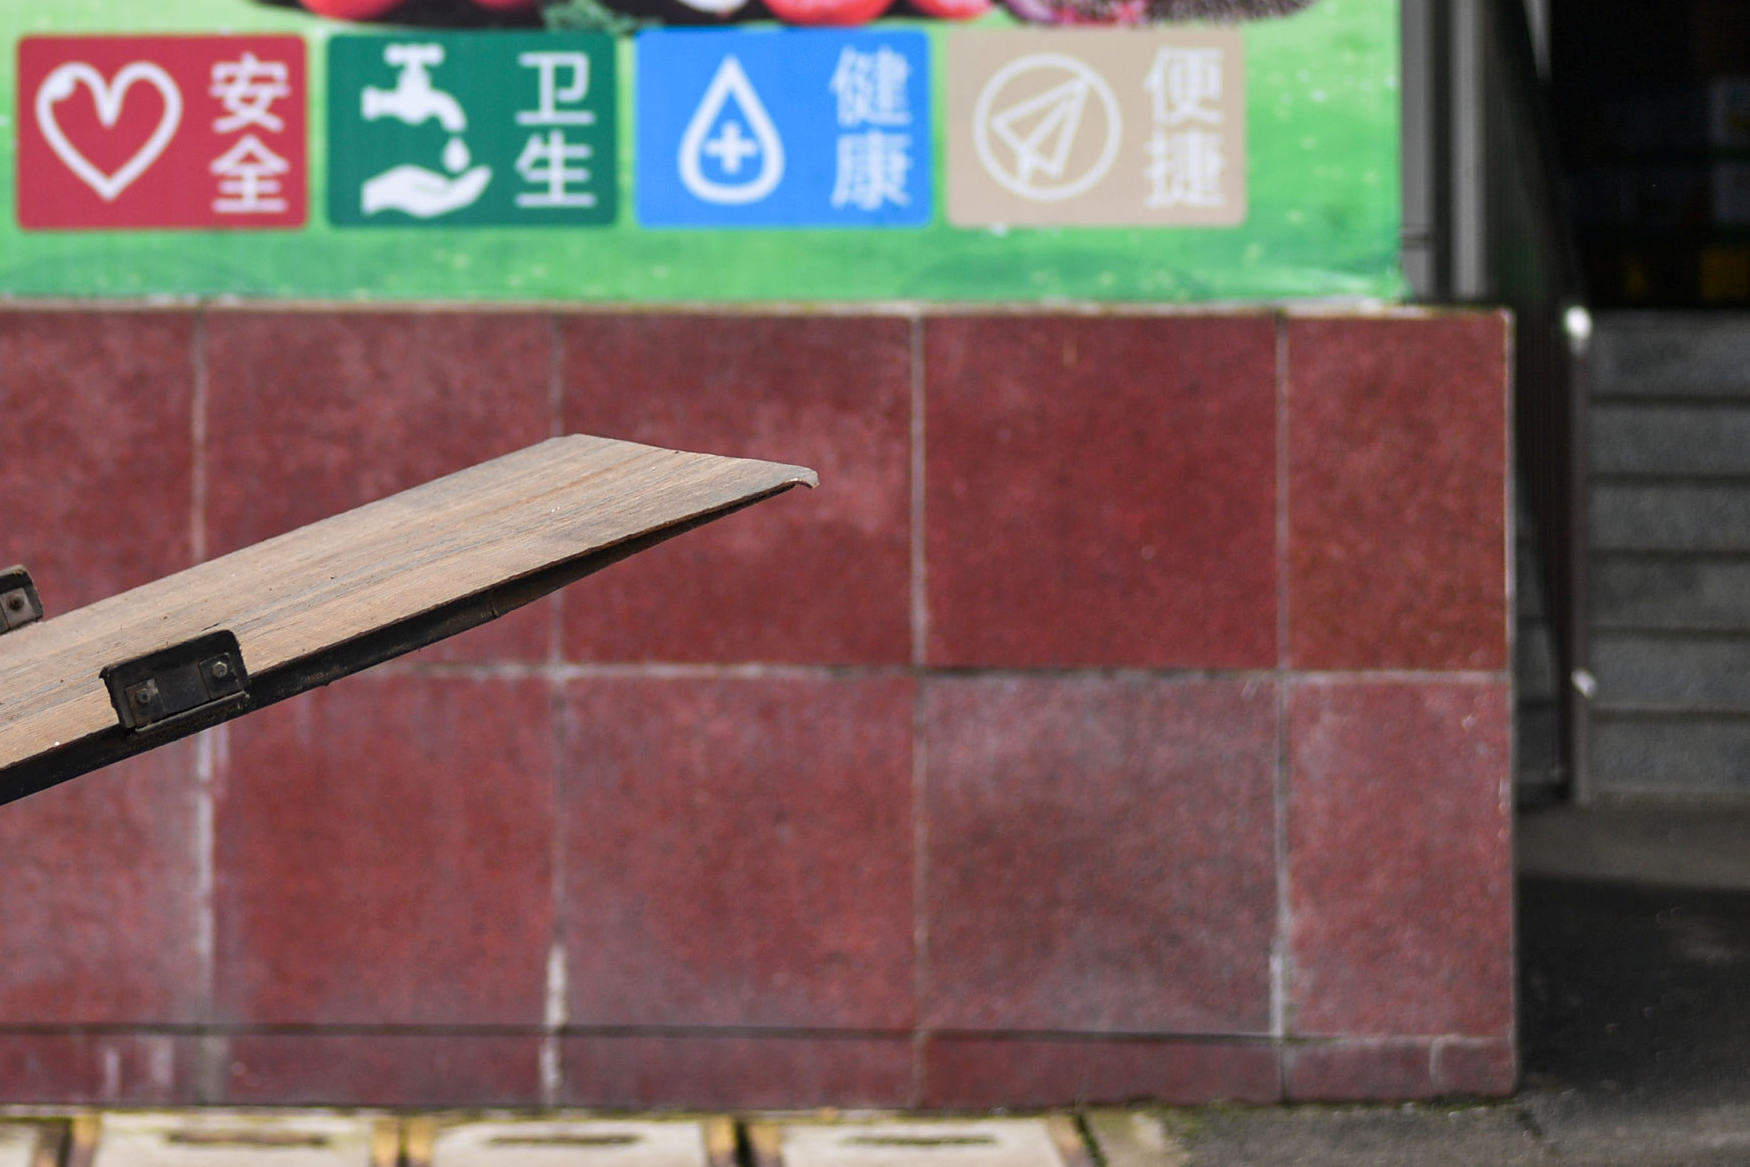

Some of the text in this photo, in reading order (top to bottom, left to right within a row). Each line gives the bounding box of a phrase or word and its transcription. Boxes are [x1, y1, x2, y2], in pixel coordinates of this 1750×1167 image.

[209, 51, 290, 213] 安全
[515, 51, 597, 209] 卫生
[829, 45, 913, 211] 健康
[1143, 45, 1227, 209] 便捷
